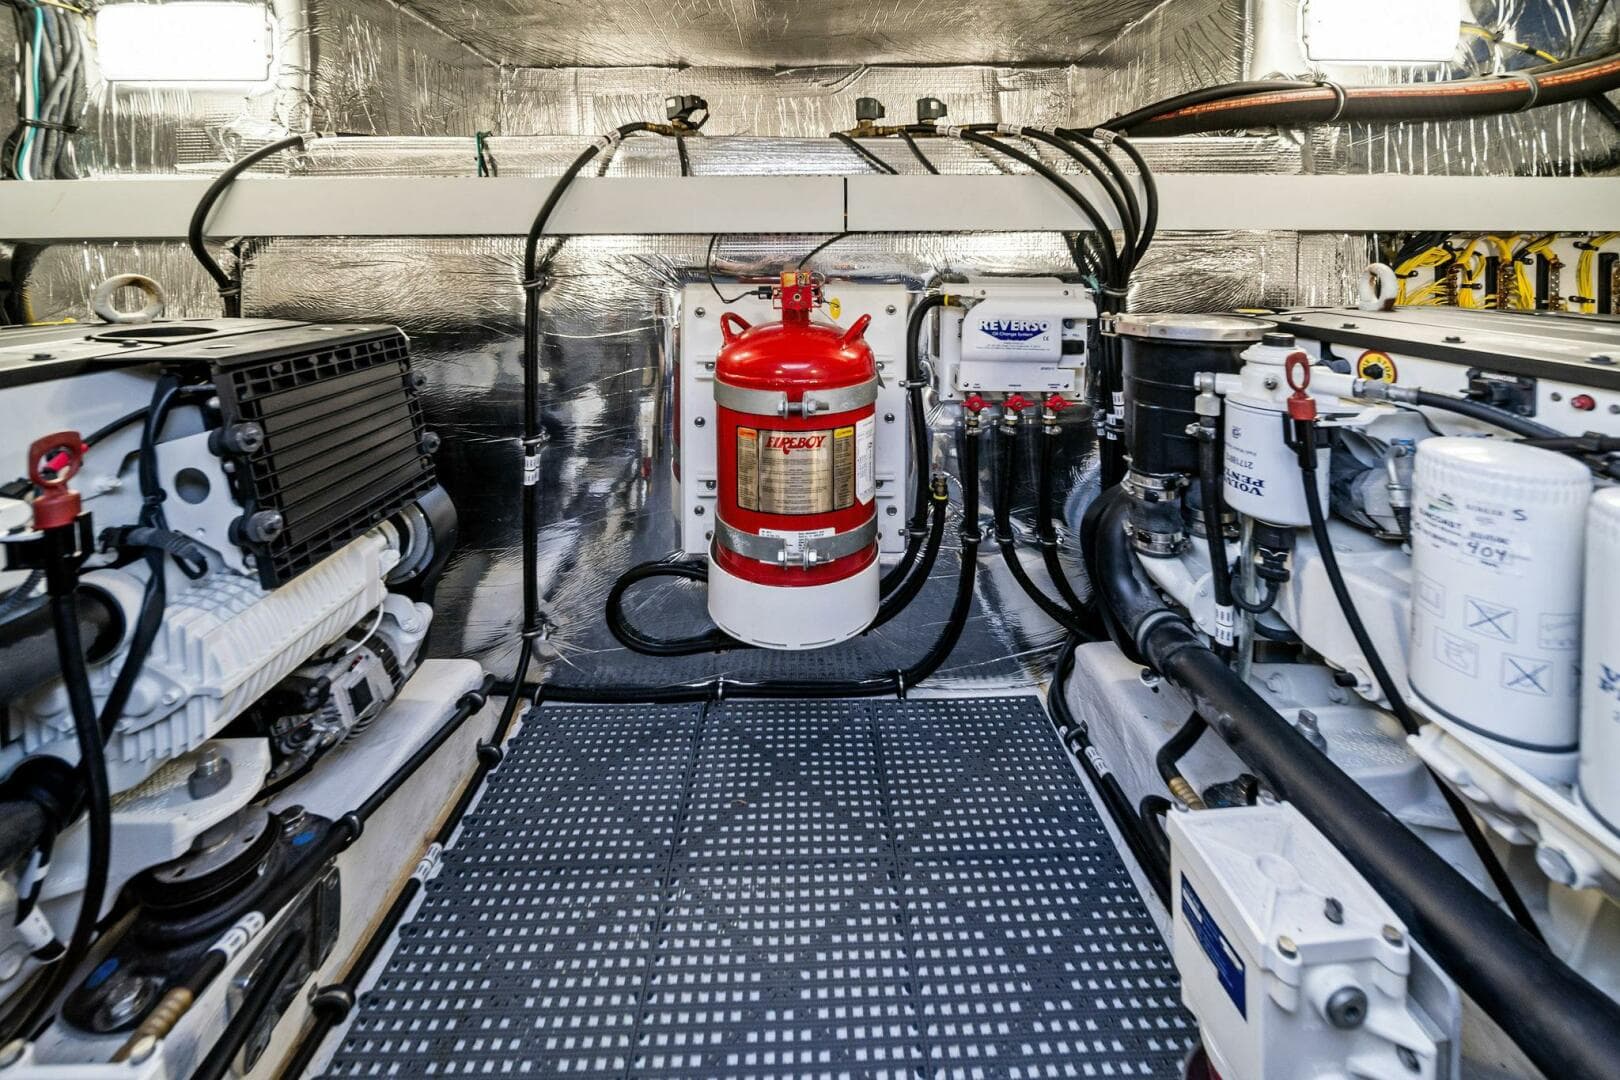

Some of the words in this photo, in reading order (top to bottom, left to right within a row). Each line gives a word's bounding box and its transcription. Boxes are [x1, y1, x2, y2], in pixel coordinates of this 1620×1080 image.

[979, 319, 1050, 331] REVERSO
[765, 435, 827, 455] FIREBOY
[1224, 466, 1265, 488] PENT
[1224, 477, 1265, 497] VOLV
